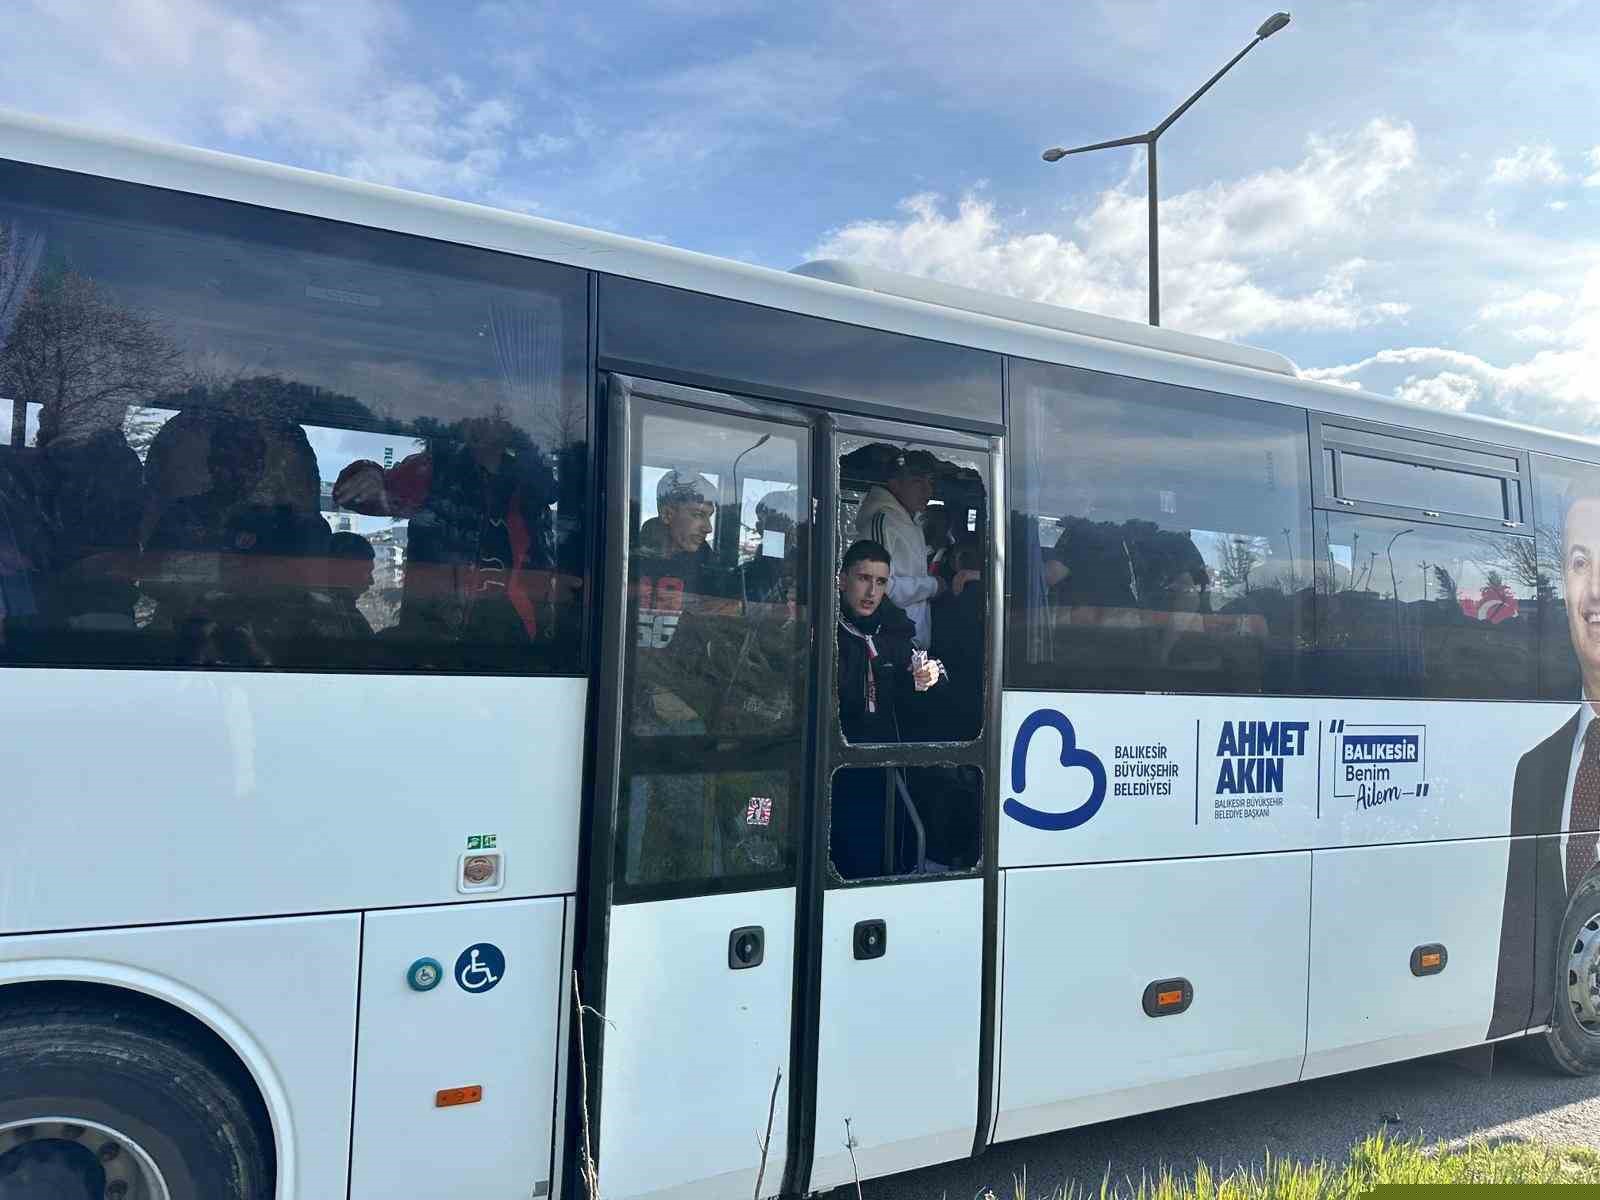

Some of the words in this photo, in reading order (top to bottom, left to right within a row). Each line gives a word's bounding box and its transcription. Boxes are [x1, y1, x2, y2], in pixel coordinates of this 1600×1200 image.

[1216, 721, 1309, 756] AHMET
[1344, 738, 1416, 760] BALIKESİR
[1115, 742, 1167, 759] BALIKESİR
[1114, 760, 1179, 780] BÜYÜKŞEHİR
[1216, 758, 1284, 794] AKIN
[1345, 764, 1390, 781] Benim
[1114, 779, 1171, 796] BELEDİYESİ
[1355, 782, 1402, 810] Ailem
